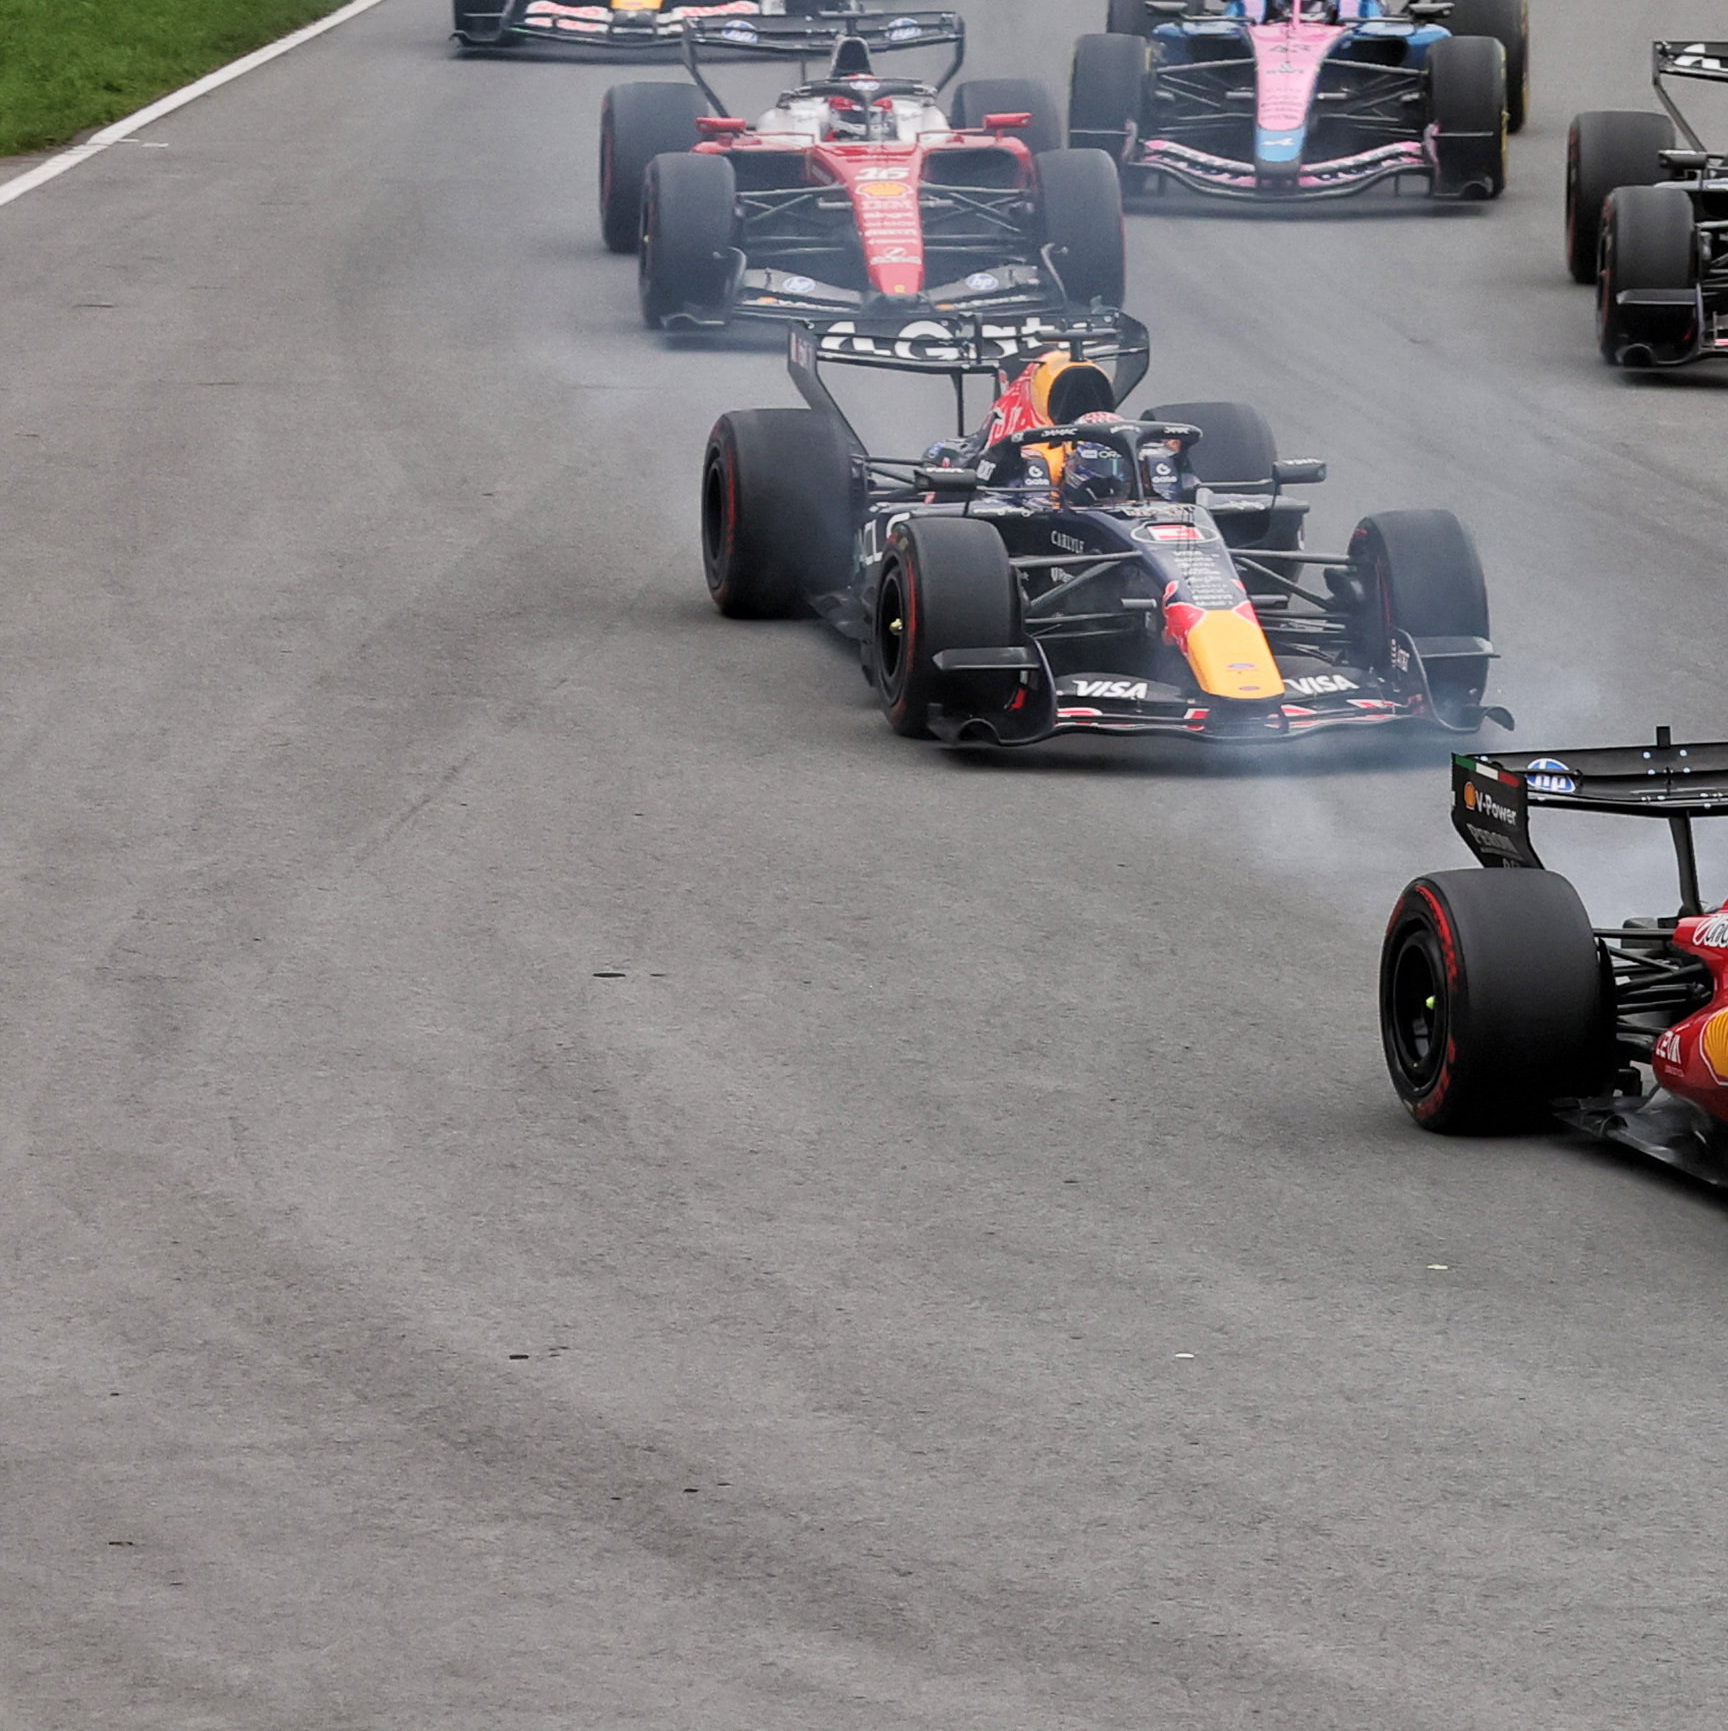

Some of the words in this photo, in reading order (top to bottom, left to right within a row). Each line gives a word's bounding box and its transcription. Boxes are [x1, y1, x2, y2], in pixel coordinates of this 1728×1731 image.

[854, 166, 911, 181] 16
[1074, 679, 1149, 700] VISA
[1284, 673, 1360, 697] VISA
[1476, 790, 1518, 826] V-Power
